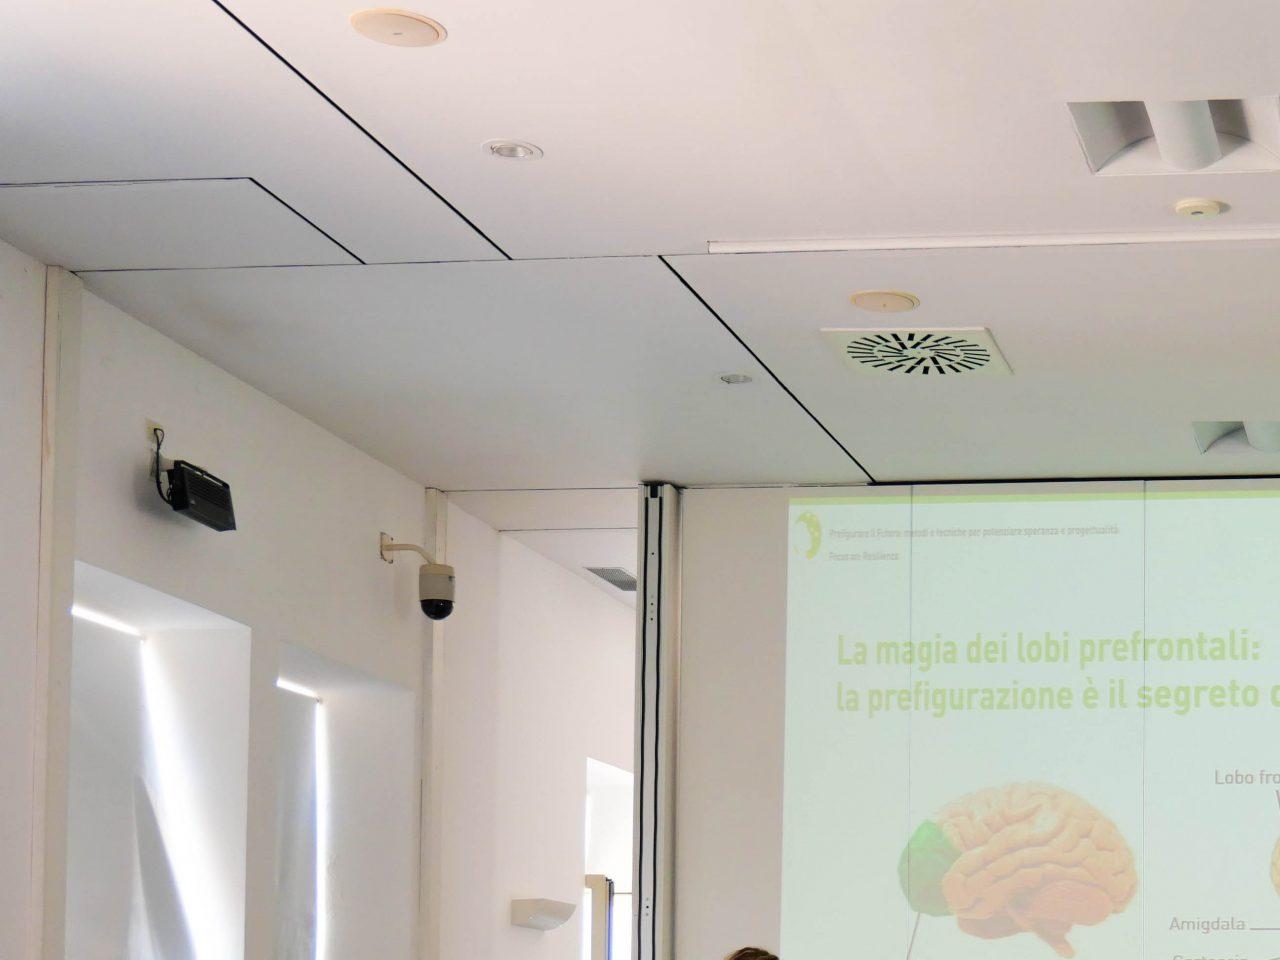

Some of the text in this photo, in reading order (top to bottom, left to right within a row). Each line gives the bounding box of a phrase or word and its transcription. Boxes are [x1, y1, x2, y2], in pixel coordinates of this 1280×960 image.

[837, 629, 1260, 673] La magia dei lobi prefrontali:
[836, 681, 861, 712] la
[866, 679, 1074, 720] prefigurazione
[1082, 676, 1100, 710] è
[1108, 677, 1128, 709] il
[1137, 679, 1260, 715] segreto
[1214, 768, 1254, 785] Lobo
[1169, 916, 1246, 935] Amigdala
